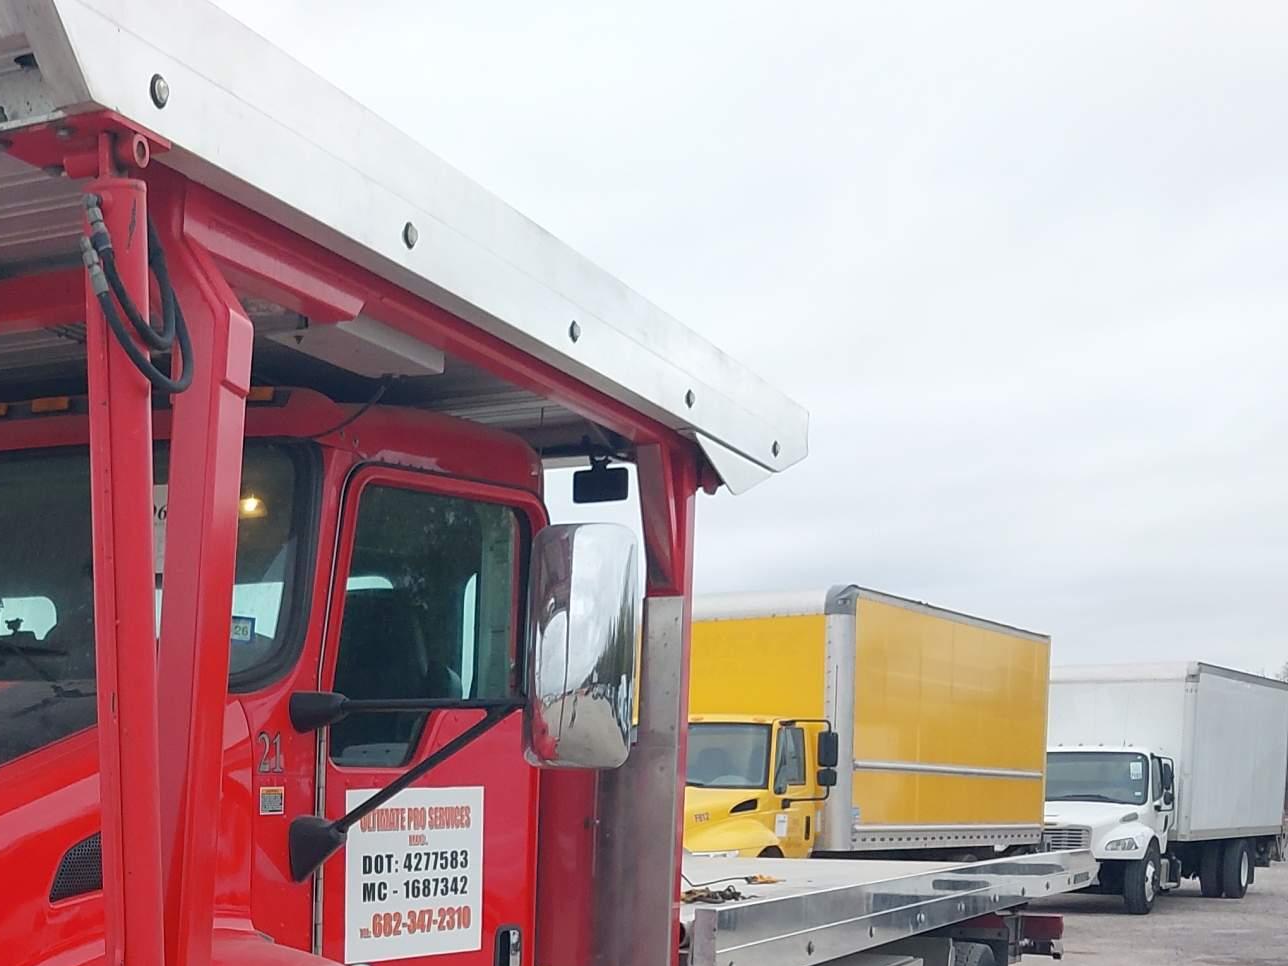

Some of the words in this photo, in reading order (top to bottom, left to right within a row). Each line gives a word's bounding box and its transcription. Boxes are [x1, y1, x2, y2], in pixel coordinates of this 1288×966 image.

[257, 731, 284, 774] 21
[360, 807, 406, 832] ULTIMATE
[407, 807, 427, 831] PRO
[428, 806, 471, 830] SERVICES
[362, 854, 398, 875] DOT:
[403, 850, 469, 872] 4277583
[362, 881, 388, 903] MC
[403, 875, 468, 899] 1687342
[372, 905, 472, 938] 682-347-2310
